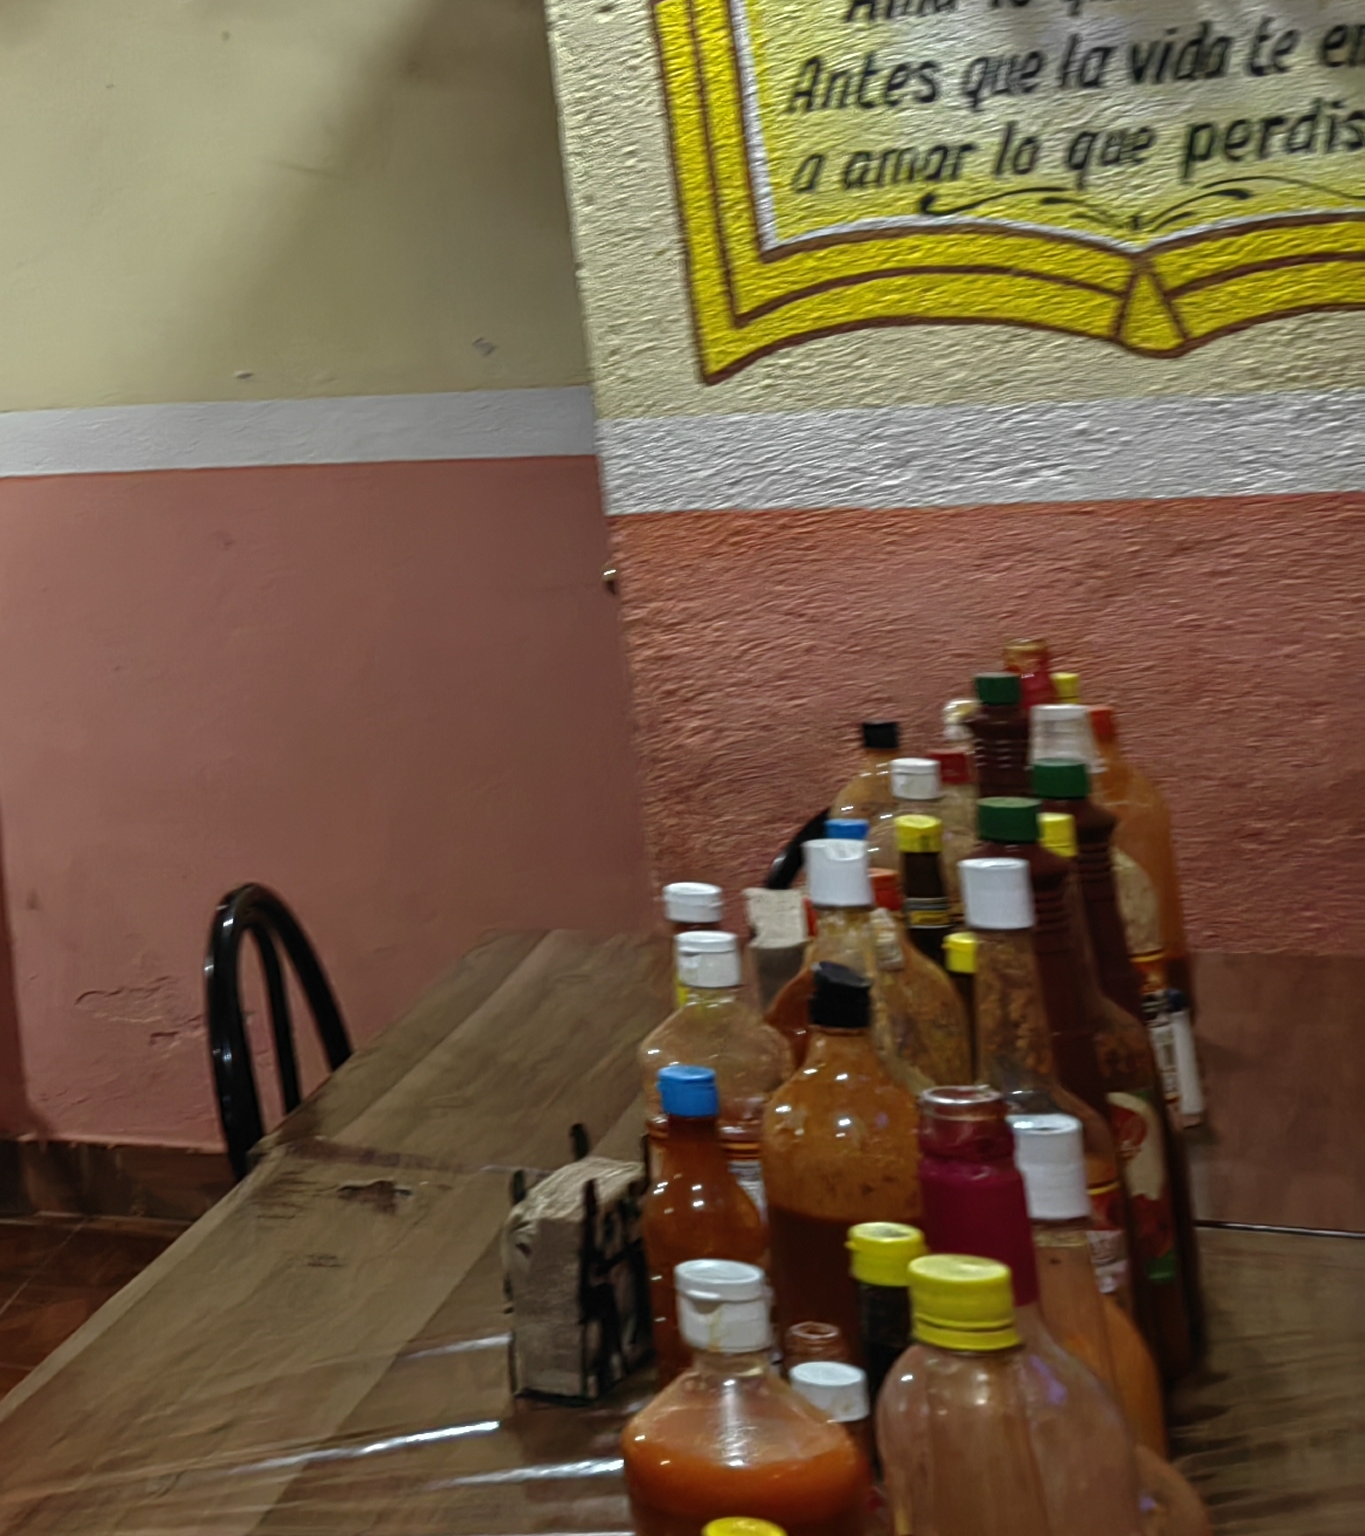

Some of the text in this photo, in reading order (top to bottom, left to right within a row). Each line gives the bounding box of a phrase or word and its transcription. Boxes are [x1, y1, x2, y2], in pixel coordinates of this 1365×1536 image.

[788, 54, 940, 113] Antes
[963, 51, 1043, 111] que
[1057, 33, 1117, 88] la
[1128, 20, 1232, 85] vida
[1248, 16, 1299, 76] te
[793, 154, 825, 194] a
[843, 143, 976, 190] amar
[993, 121, 1037, 176] lo
[1065, 126, 1155, 191] que
